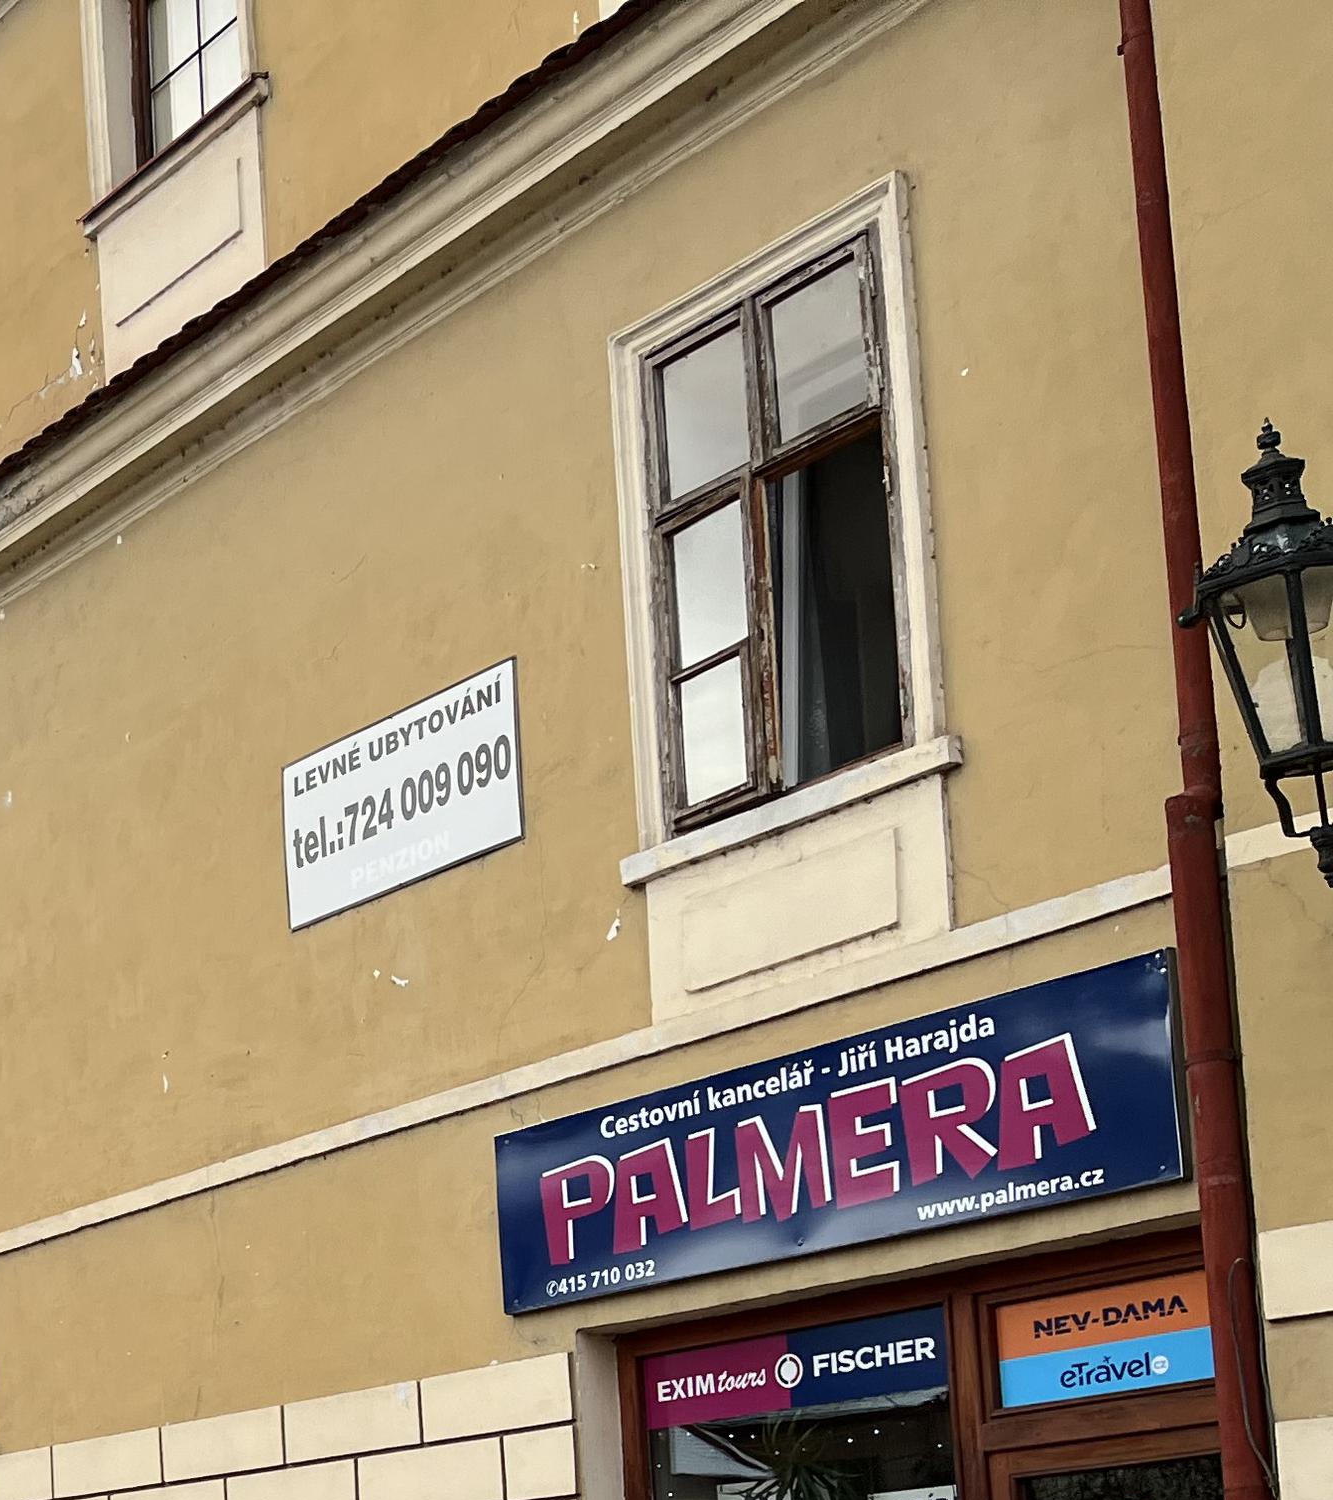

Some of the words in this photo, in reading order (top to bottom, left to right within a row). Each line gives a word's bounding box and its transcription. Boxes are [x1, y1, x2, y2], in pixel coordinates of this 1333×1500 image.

[293, 742, 362, 798] LEVNÉ
[368, 673, 502, 763] UBYTOVÁNÍ
[400, 760, 452, 822] 009
[457, 733, 512, 797] 090
[599, 1089, 702, 1139] Cestovní
[707, 1059, 816, 1114] kancelář
[837, 1041, 879, 1078] Jiří
[884, 1013, 996, 1064] Harajda
[539, 1031, 1099, 1267] PALMERA
[917, 1167, 1106, 1222] www.palmera.cz
[590, 1266, 621, 1289] 710
[624, 1258, 657, 1282] 032
[1033, 1294, 1189, 1339] NEV-DAMA
[812, 1336, 936, 1378] FISCHER
[656, 1372, 716, 1403] EXIM
[716, 1367, 768, 1392] tours
